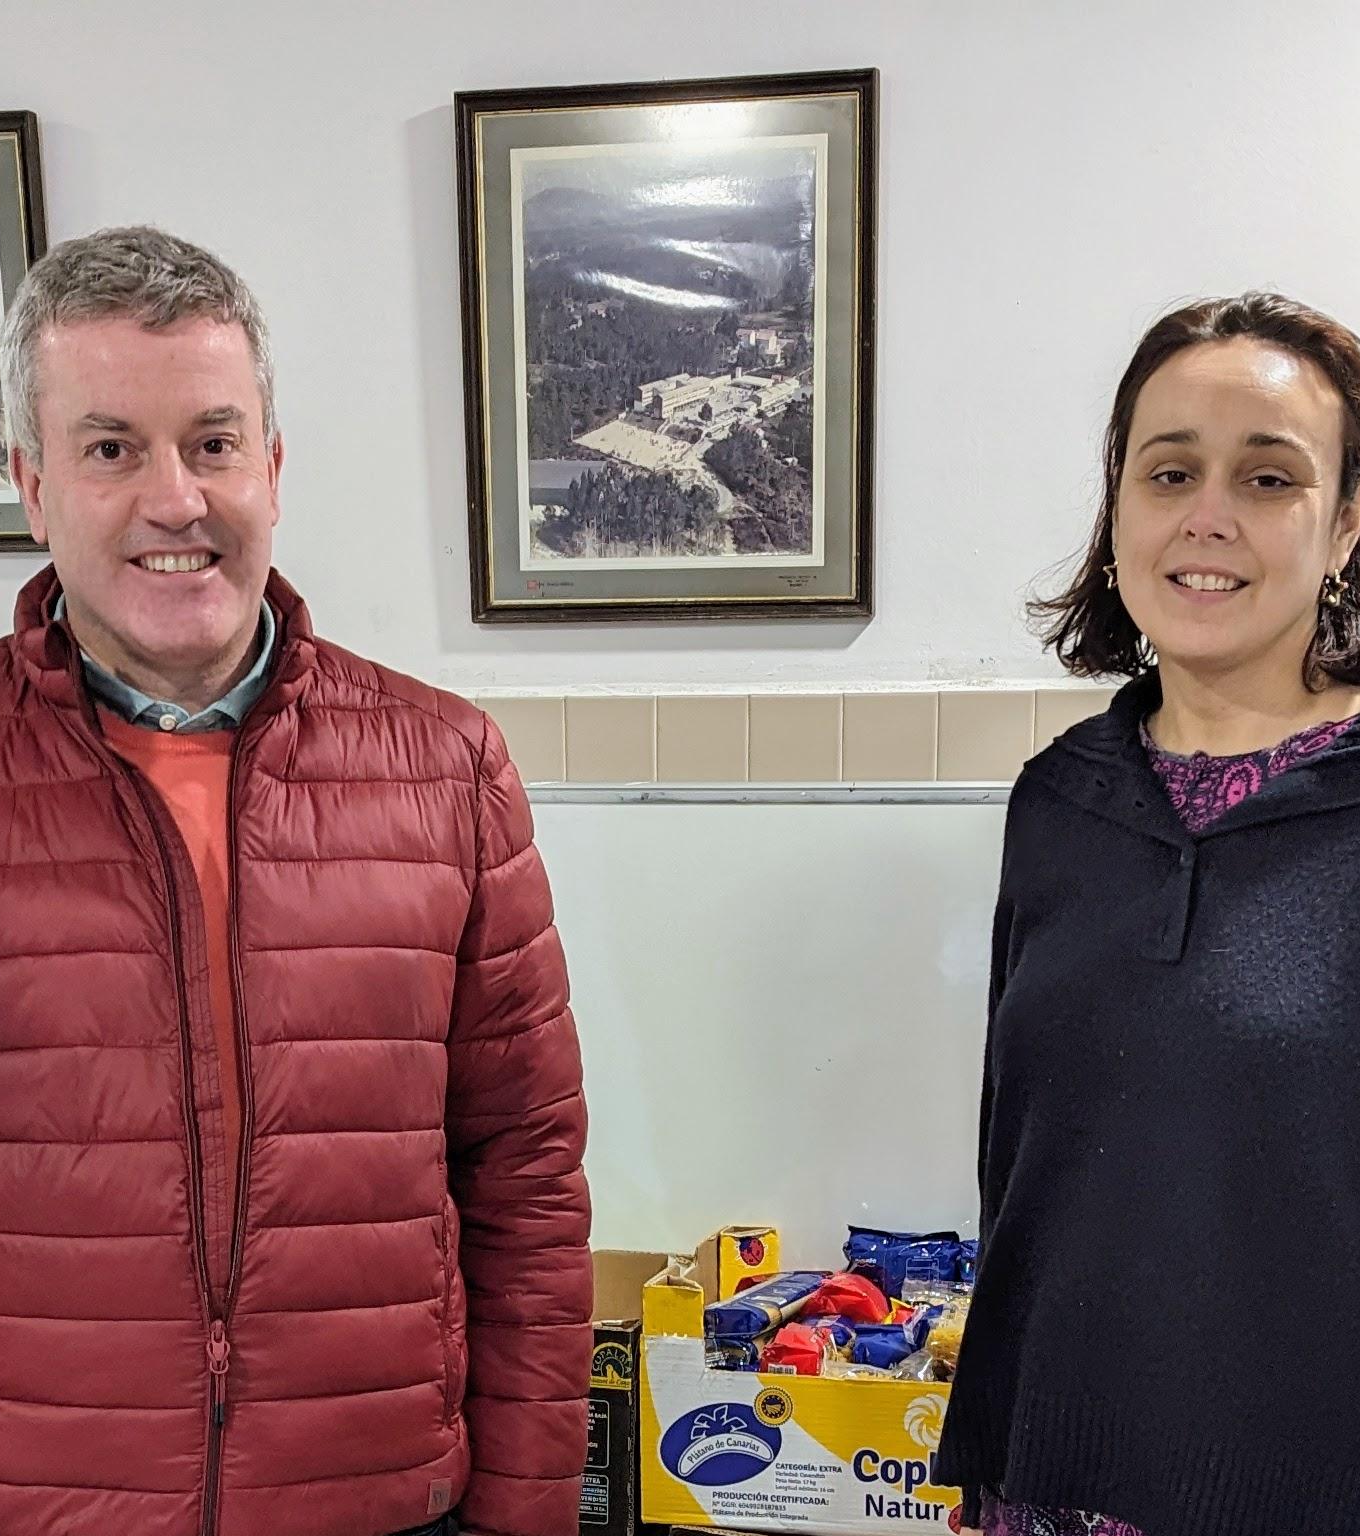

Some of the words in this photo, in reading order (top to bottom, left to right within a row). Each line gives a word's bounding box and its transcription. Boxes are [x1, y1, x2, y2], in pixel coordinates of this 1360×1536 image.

[687, 1443, 714, 1464] Plátano
[715, 1439, 725, 1449] de
[853, 1449, 939, 1494] Copl
[712, 1491, 769, 1502] PRODUCCIÓN
[770, 1494, 829, 1505] CERTIFICADA:
[865, 1494, 944, 1520] Natur
